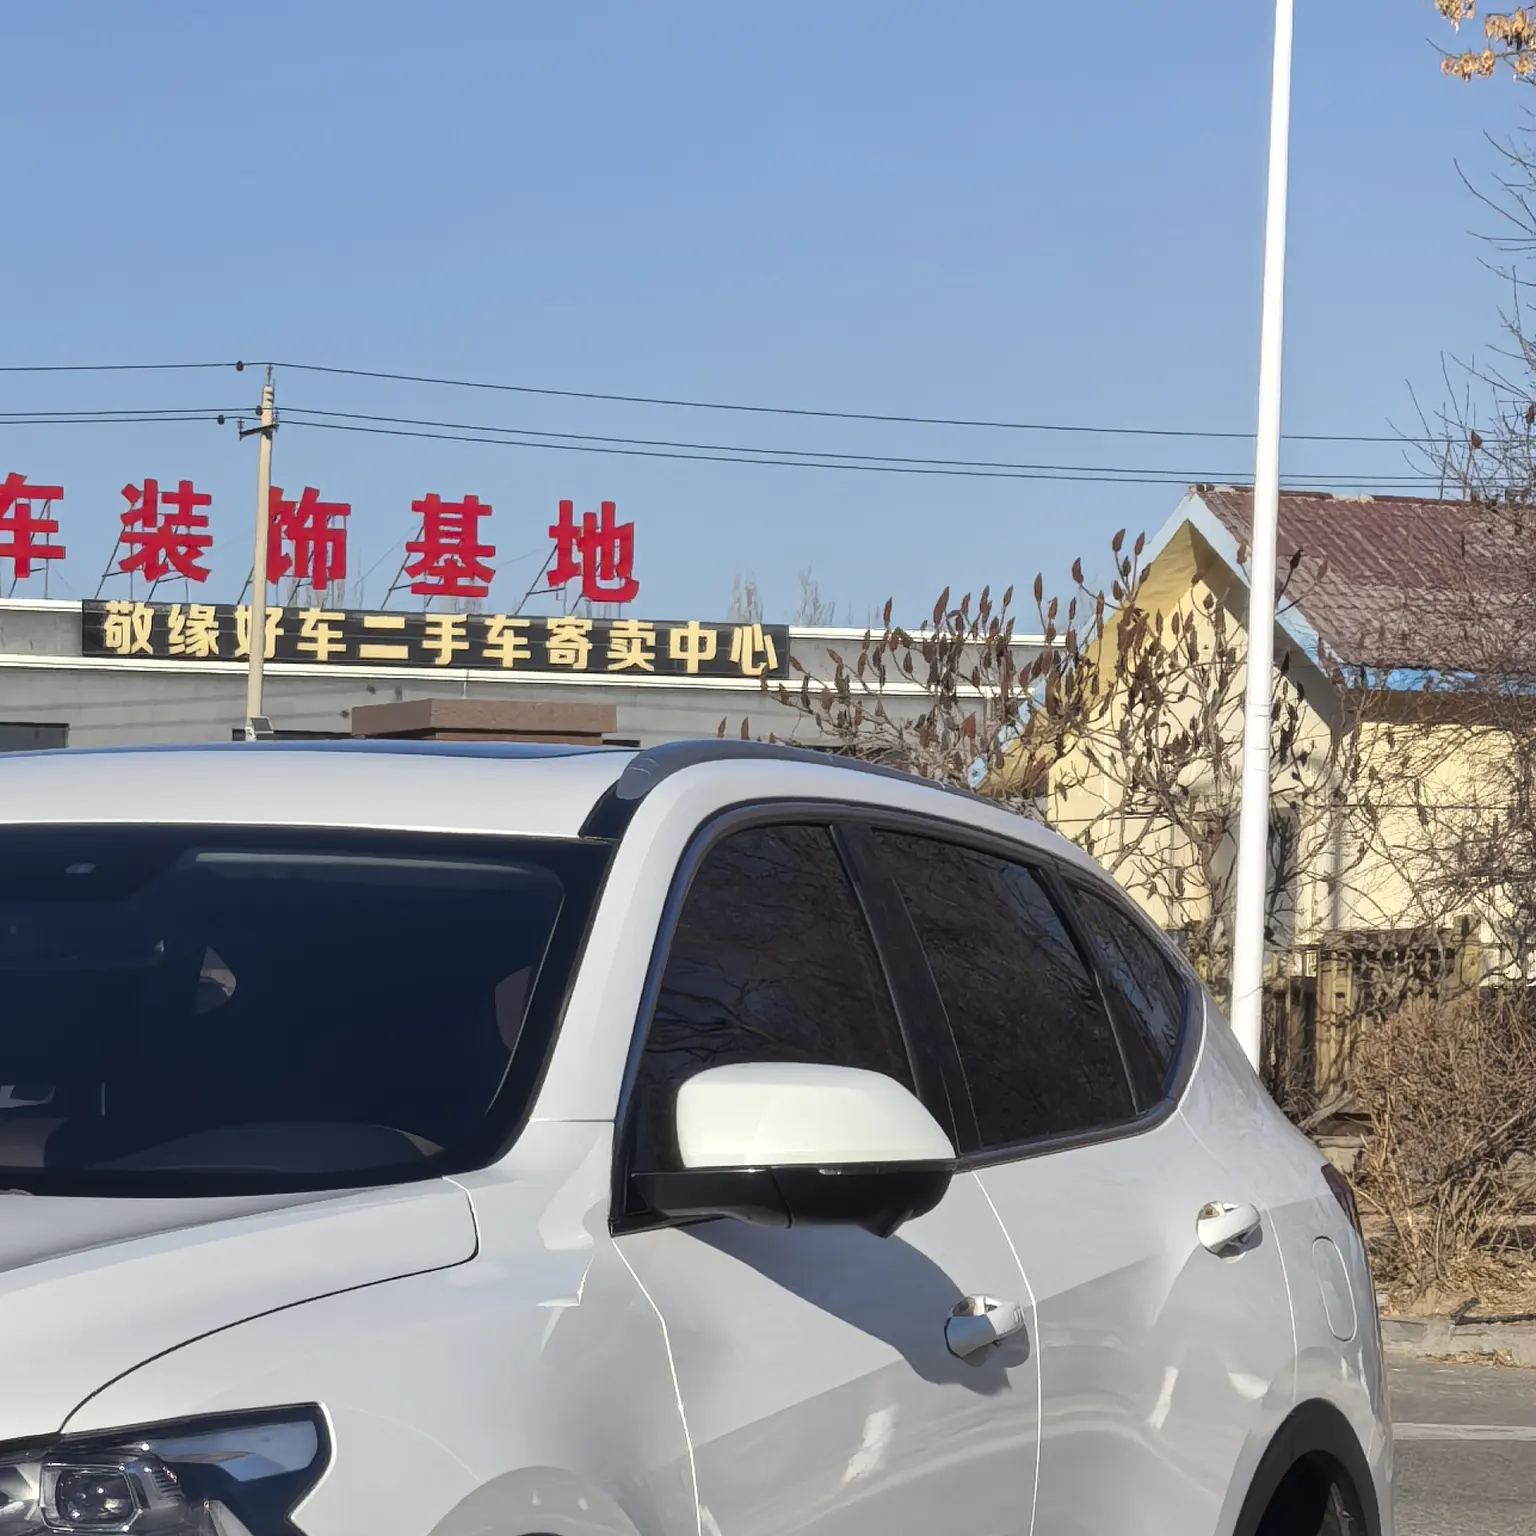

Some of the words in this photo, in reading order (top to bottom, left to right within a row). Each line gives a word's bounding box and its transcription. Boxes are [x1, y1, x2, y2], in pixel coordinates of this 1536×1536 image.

[104, 601, 778, 676] 敬缘好车二手车寄卖中心
